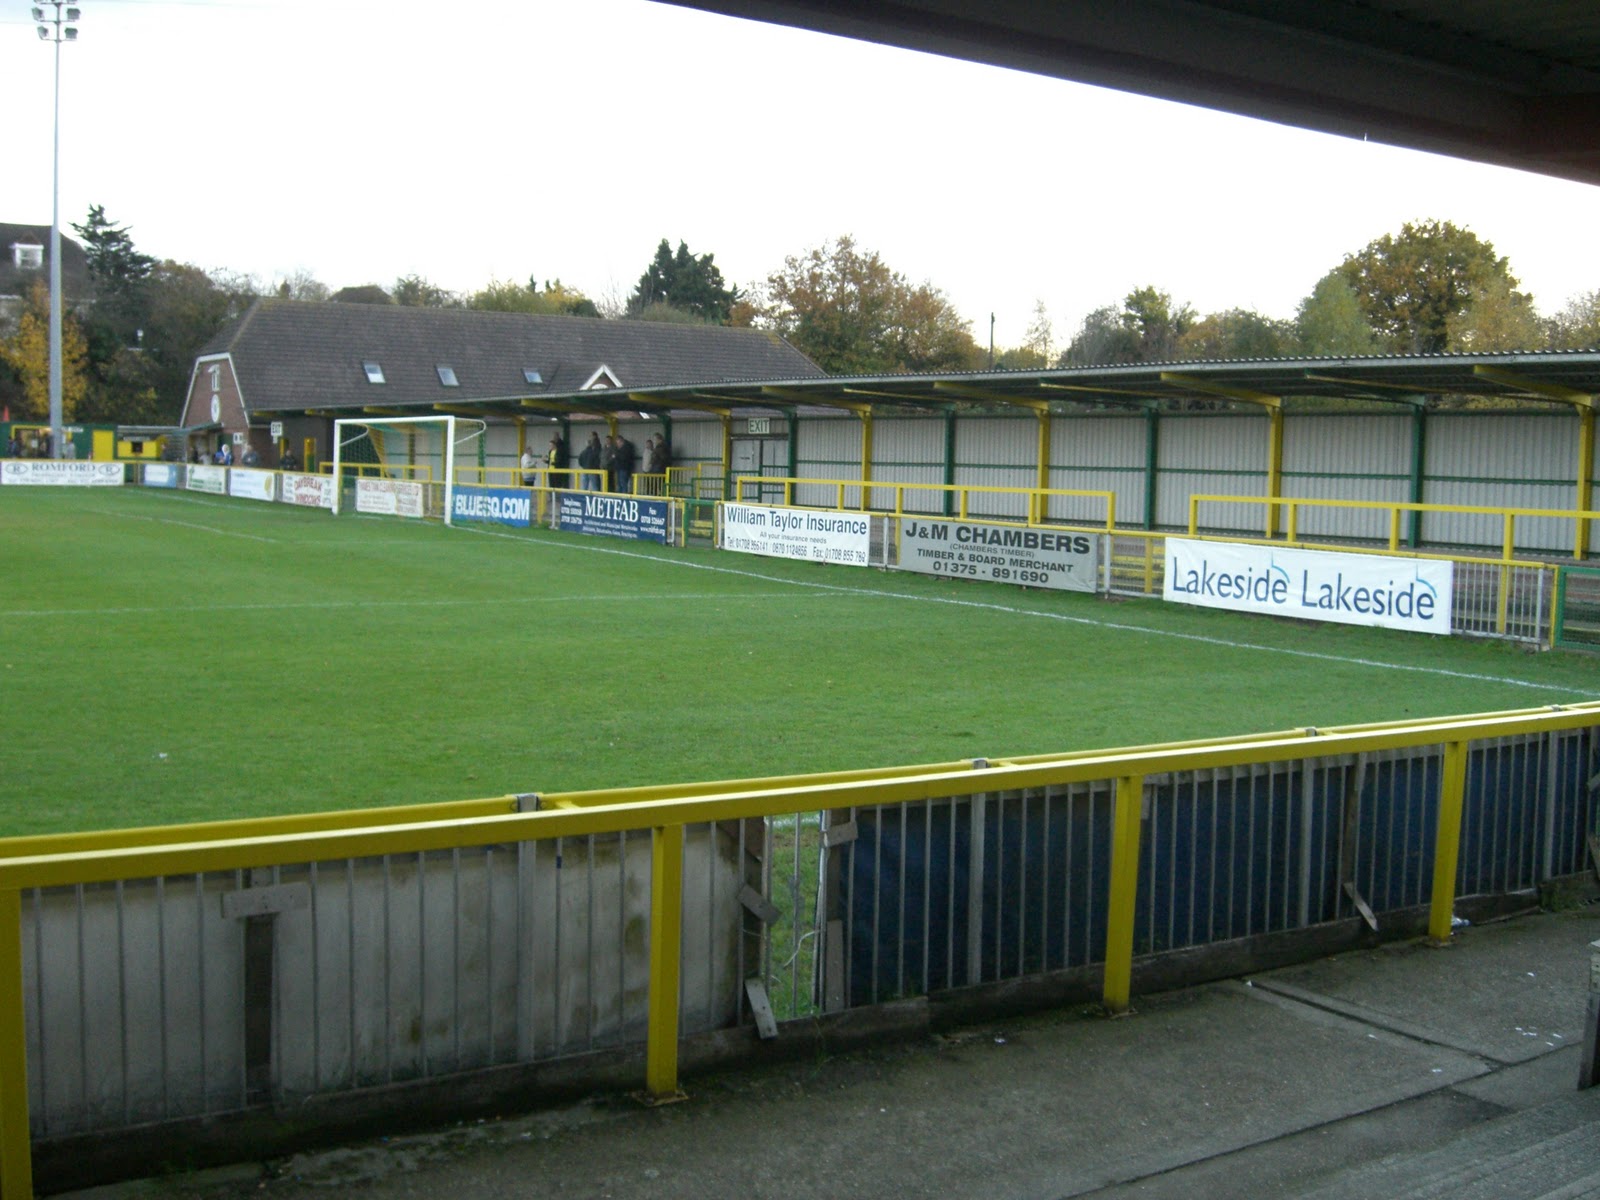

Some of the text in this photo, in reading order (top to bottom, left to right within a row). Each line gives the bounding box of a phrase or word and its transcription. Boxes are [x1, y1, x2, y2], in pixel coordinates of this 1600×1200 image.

[749, 420, 770, 433] EXIT
[32, 463, 96, 472] ROMFORD
[455, 494, 530, 520] BLUESQ.COM
[585, 496, 639, 523] METFAB
[726, 506, 867, 535] William Taylor Insurance
[768, 533, 780, 541] your
[781, 533, 808, 543] insurance
[905, 522, 1090, 554] J&M CHAMBERS
[950, 542, 1035, 559] (CHAMBERS TIMBER)
[917, 548, 1074, 573] TIMBER & BOARD MERCHANT
[932, 561, 977, 576] 01375
[992, 568, 1049, 584] 891690
[1173, 556, 1435, 620] Lakeside Lakeside
